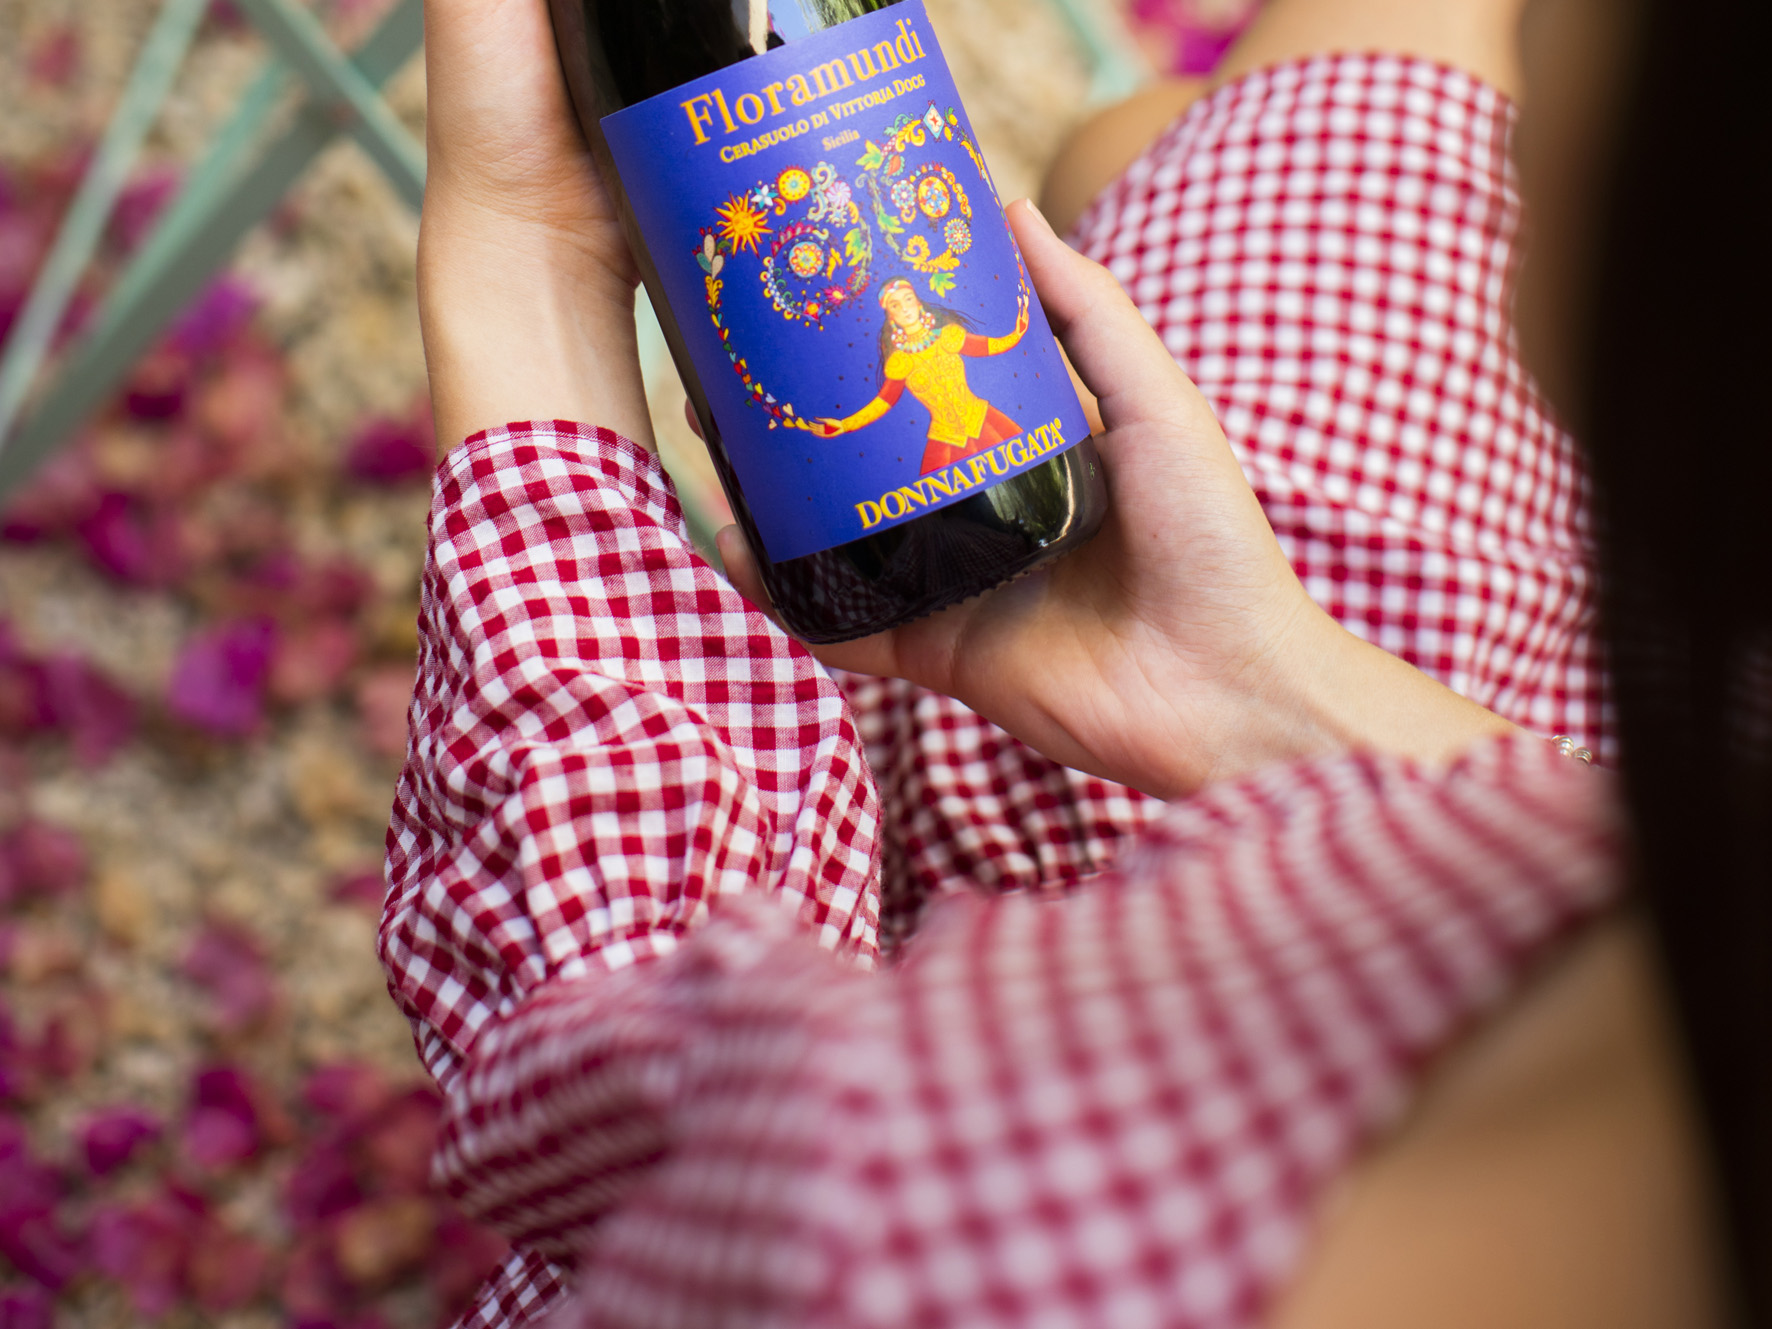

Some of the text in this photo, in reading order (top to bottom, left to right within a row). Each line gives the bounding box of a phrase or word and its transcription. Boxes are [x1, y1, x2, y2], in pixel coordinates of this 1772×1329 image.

[680, 18, 926, 146] Floramundi
[720, 118, 810, 163] CERASUOLO
[811, 111, 829, 130] DI
[828, 88, 895, 121] VITTORIA
[822, 128, 860, 152] Sicilia
